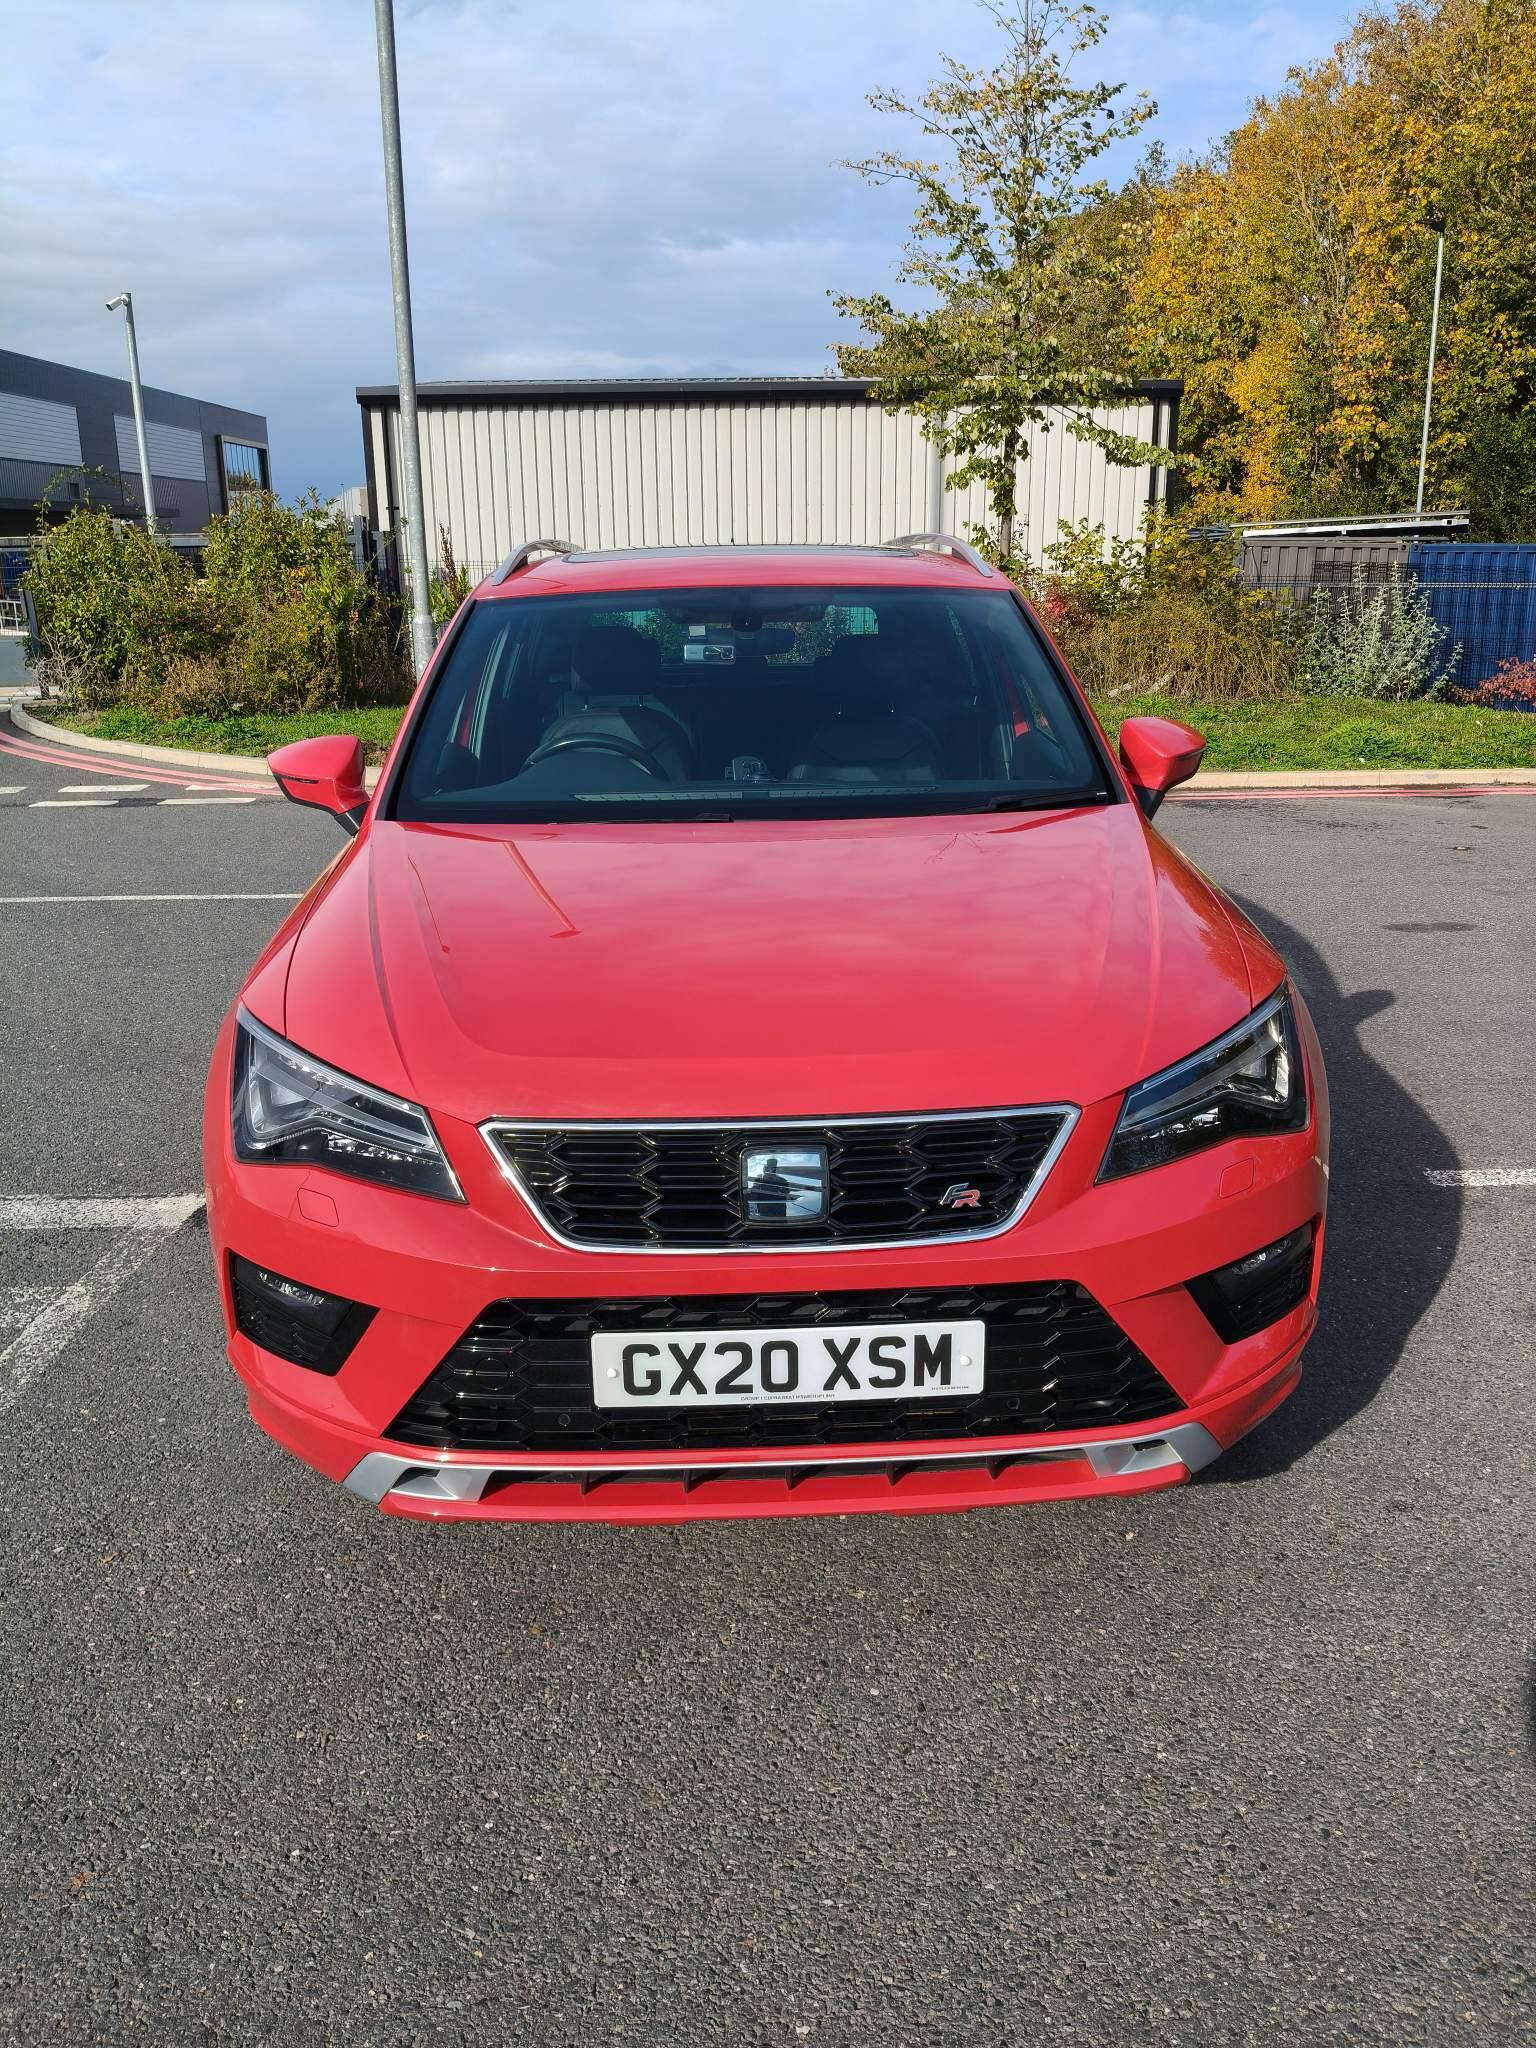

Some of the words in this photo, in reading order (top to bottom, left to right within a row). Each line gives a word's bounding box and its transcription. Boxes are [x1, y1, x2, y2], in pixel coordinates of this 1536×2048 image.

[939, 1182, 981, 1208] FR
[622, 1342, 800, 1396] GX20
[822, 1339, 952, 1391] XSM
